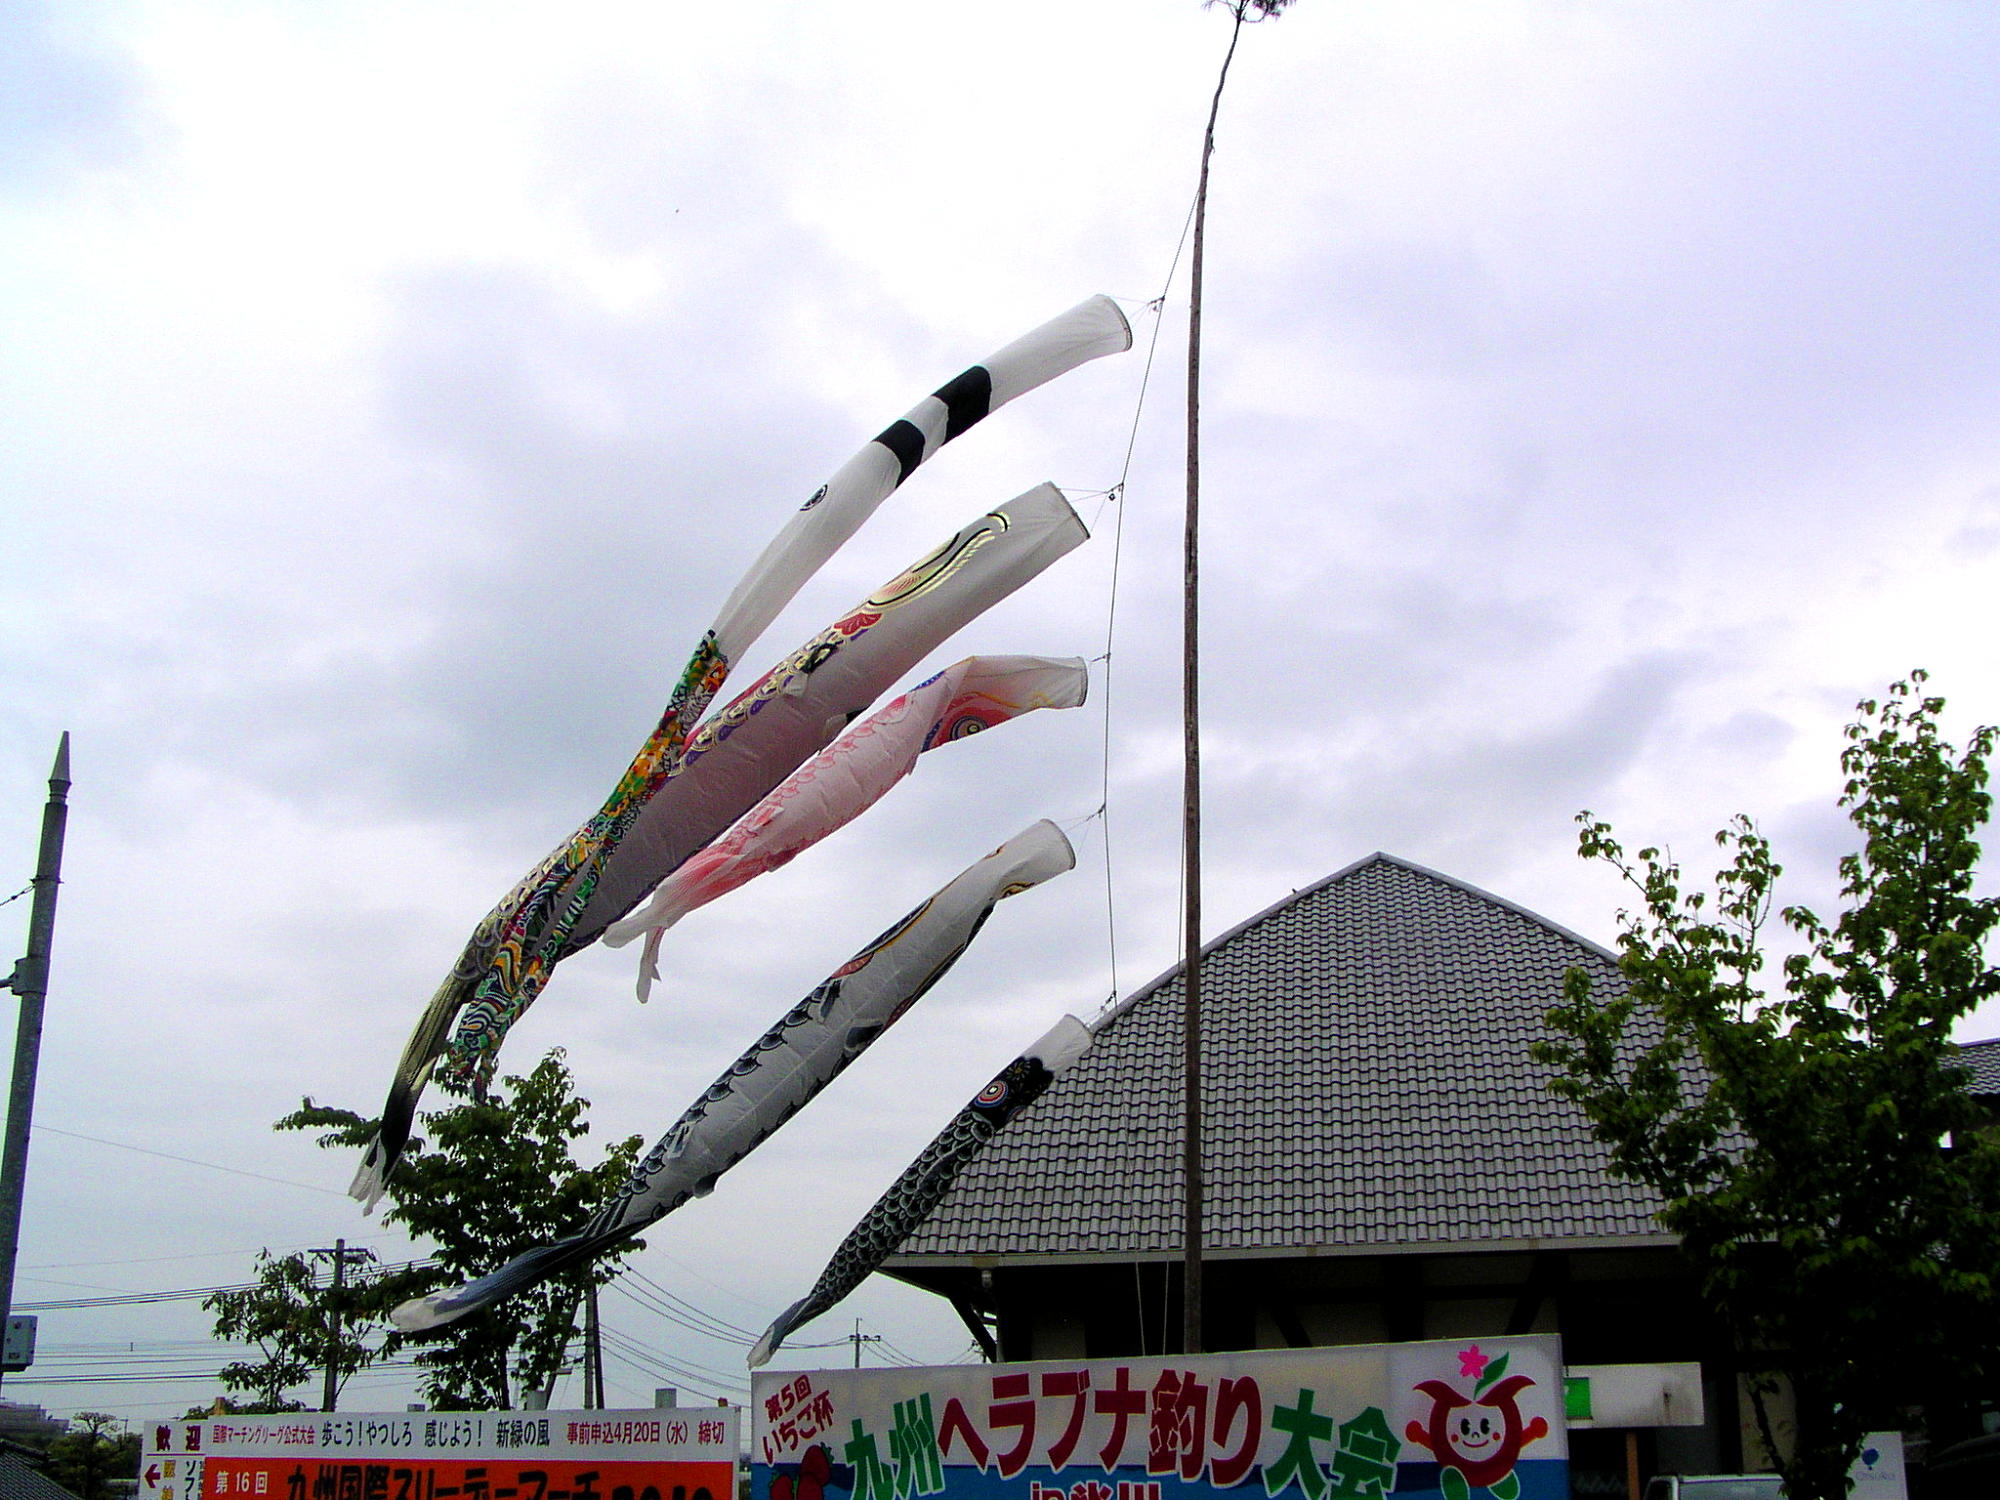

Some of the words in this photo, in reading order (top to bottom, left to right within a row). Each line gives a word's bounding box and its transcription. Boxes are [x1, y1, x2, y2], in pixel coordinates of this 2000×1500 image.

[765, 1374, 812, 1423] 第5回
[424, 1420, 482, 1447] 感じよう！
[496, 1419, 549, 1448] 新緑の風
[763, 1390, 834, 1465] いちご杯
[215, 1471, 268, 1495] 第16回
